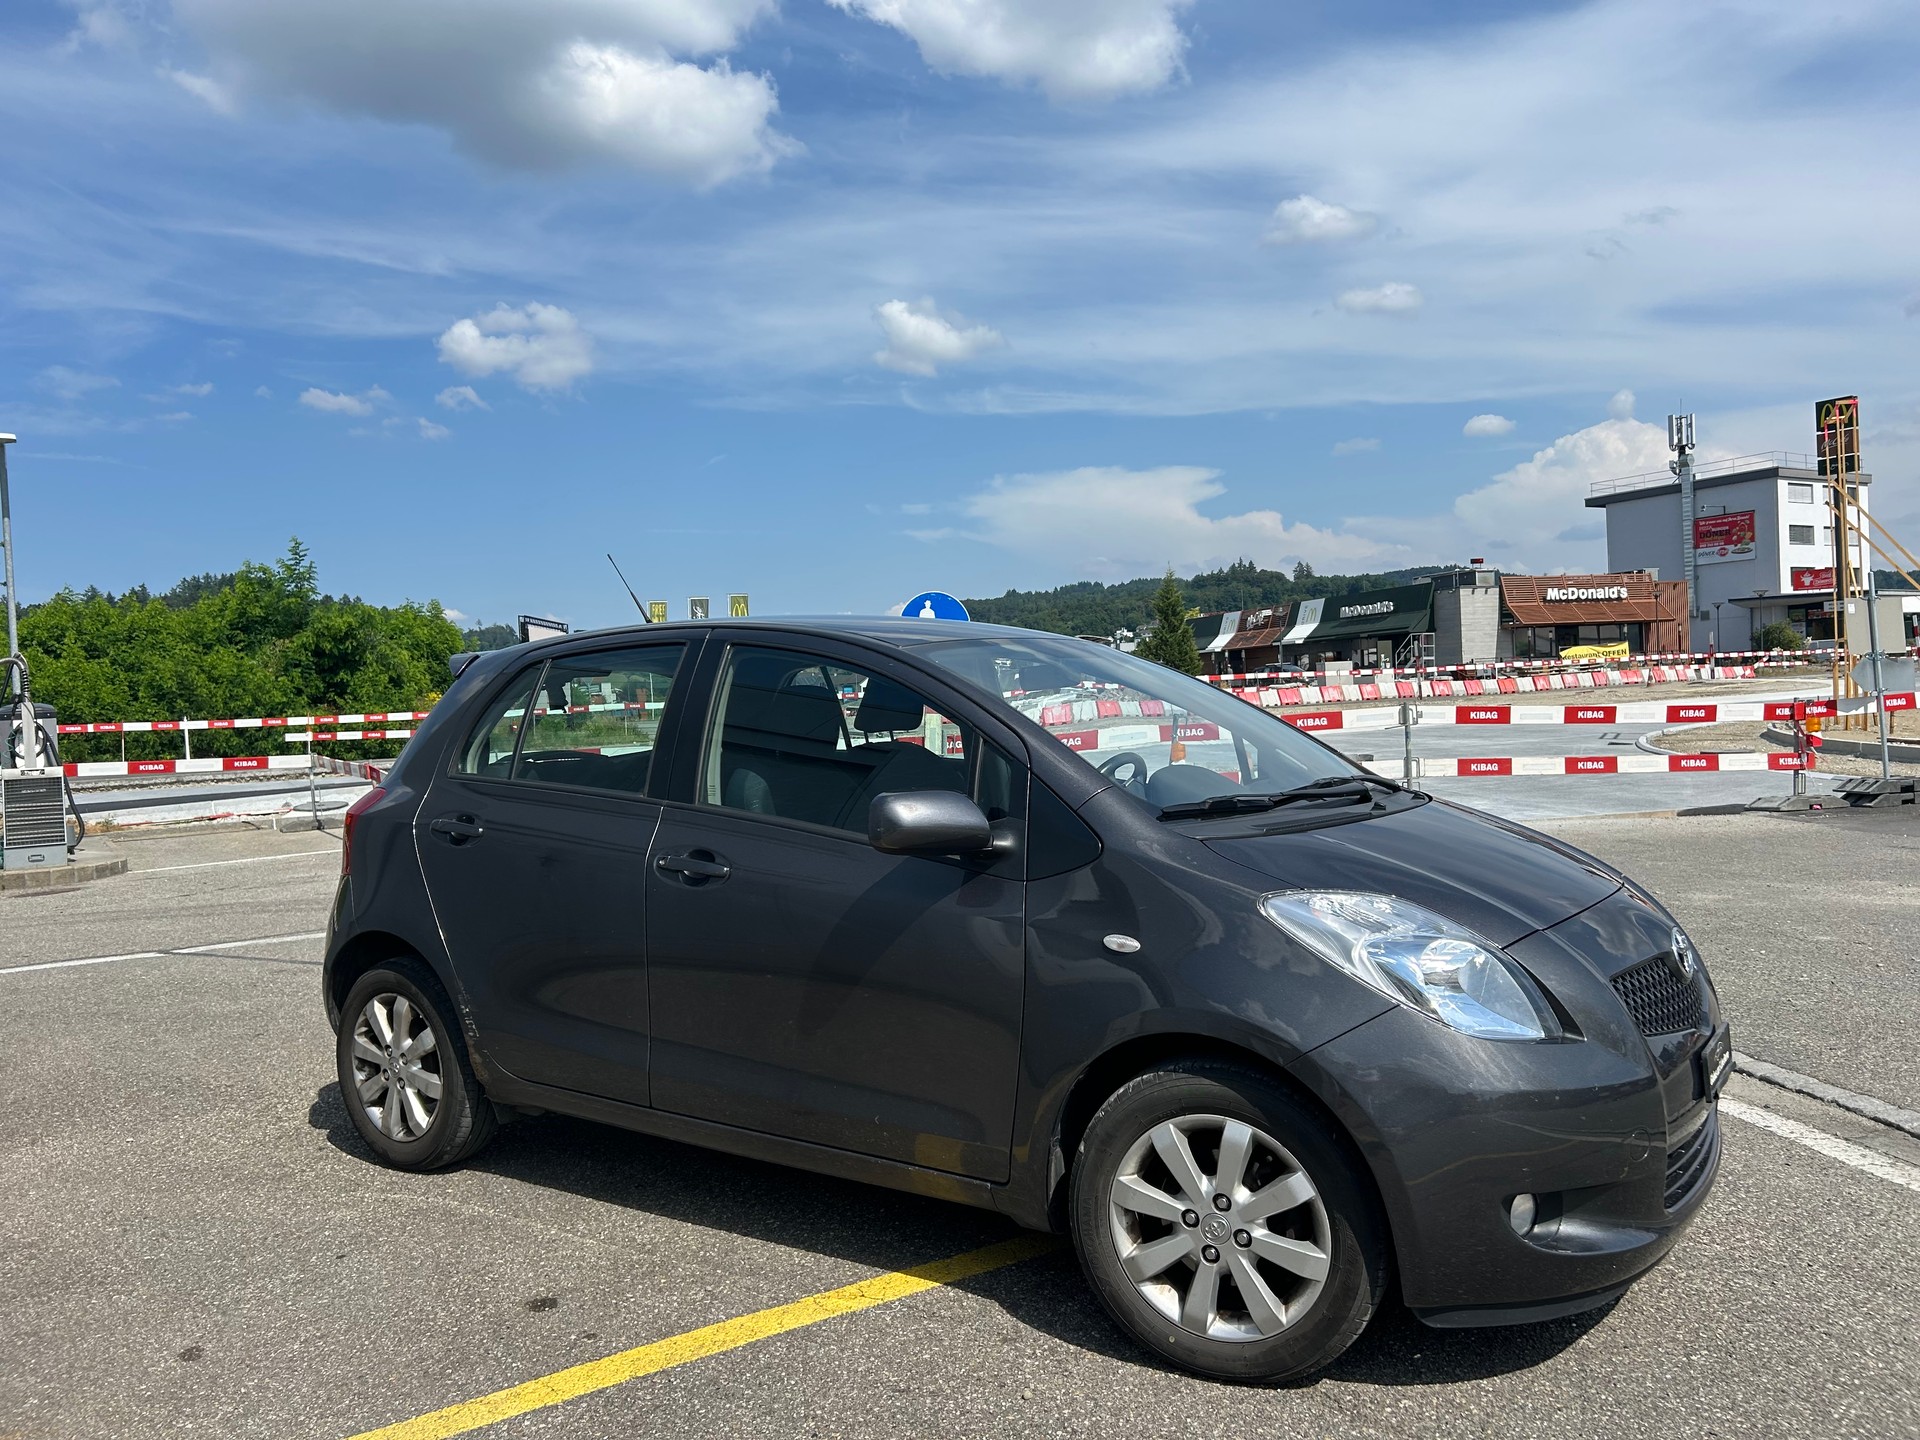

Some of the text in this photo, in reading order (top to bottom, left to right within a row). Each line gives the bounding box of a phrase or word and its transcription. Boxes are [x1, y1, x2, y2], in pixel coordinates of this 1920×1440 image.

[1546, 586, 1628, 600] McDonald's
[1340, 600, 1394, 618] McDonald's
[1602, 649, 1627, 658] OFFEN
[1885, 698, 1907, 706] KIBAG
[1679, 709, 1705, 718] KIBAG
[1805, 705, 1827, 715] KIBAG
[1470, 711, 1499, 719] KIBAG
[1577, 711, 1604, 719] KIBAG
[1296, 717, 1328, 727] KIBAG
[234, 760, 258, 768] KIBAG
[1470, 763, 1498, 771] KIBAG
[1577, 761, 1604, 769] KIBAG
[1680, 759, 1707, 768] KIBAG
